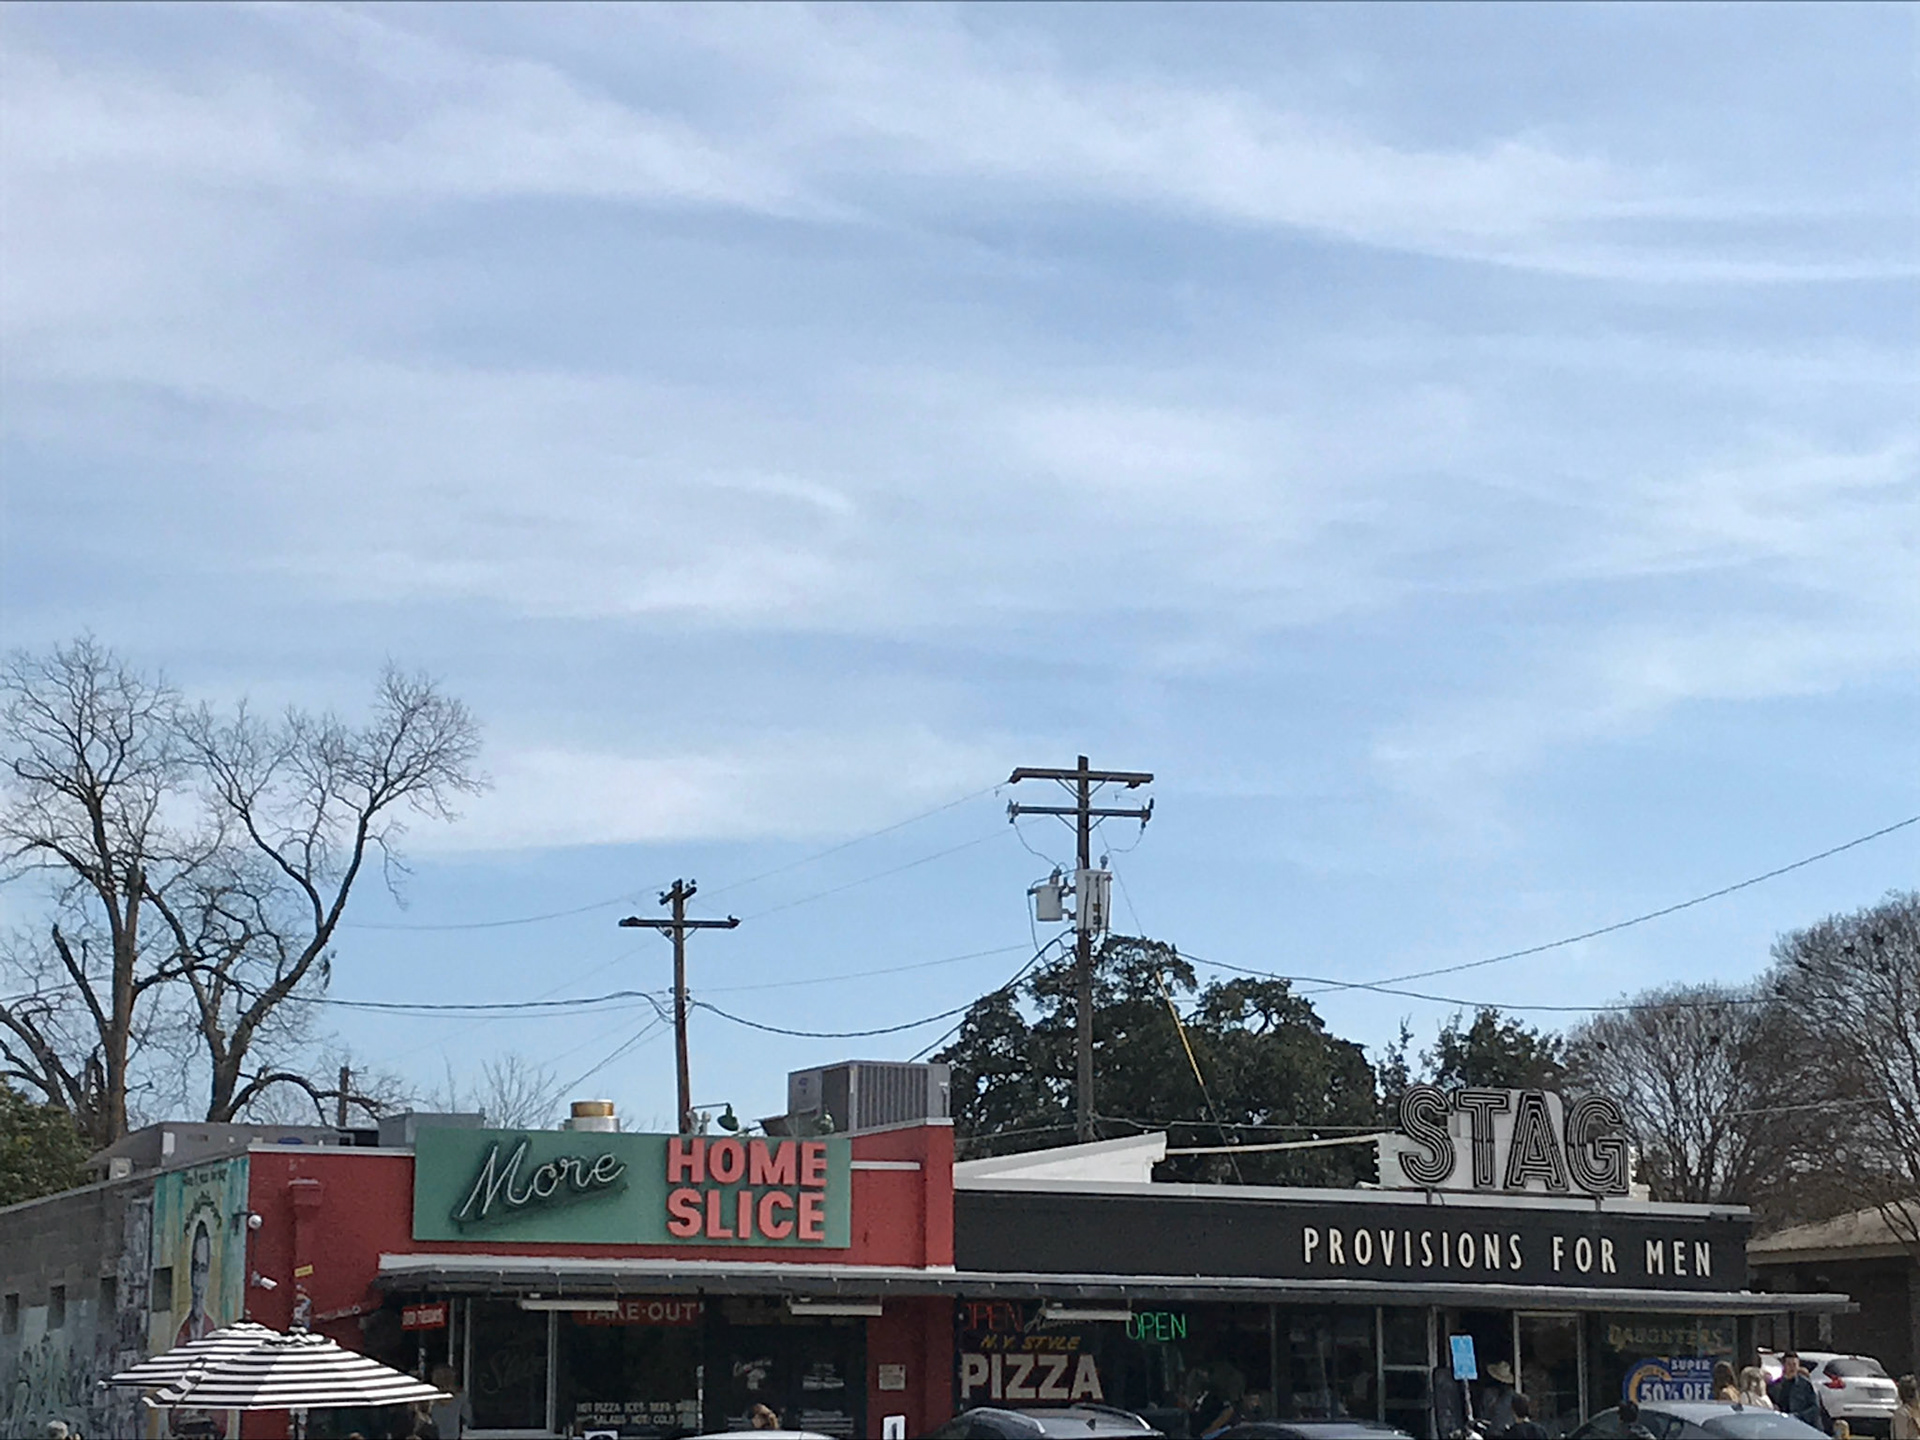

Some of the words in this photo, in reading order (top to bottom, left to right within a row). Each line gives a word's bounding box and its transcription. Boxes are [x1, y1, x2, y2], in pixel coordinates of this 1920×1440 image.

[668, 1137, 827, 1187] HOME
[1399, 1086, 1629, 1194] STAG
[456, 1141, 627, 1218] More
[667, 1188, 825, 1241] SLICE
[1303, 1227, 1522, 1270] PROVISIONS
[1552, 1236, 1617, 1274] FOR
[1645, 1239, 1710, 1277] MEN
[1021, 1336, 1081, 1350] STYLE
[1126, 1312, 1186, 1341] OPEN
[961, 1354, 1104, 1400] PIZZA
[1670, 1359, 1711, 1371] SUPER
[1640, 1382, 1680, 1402] 50%
[1681, 1382, 1712, 1401] OFF
